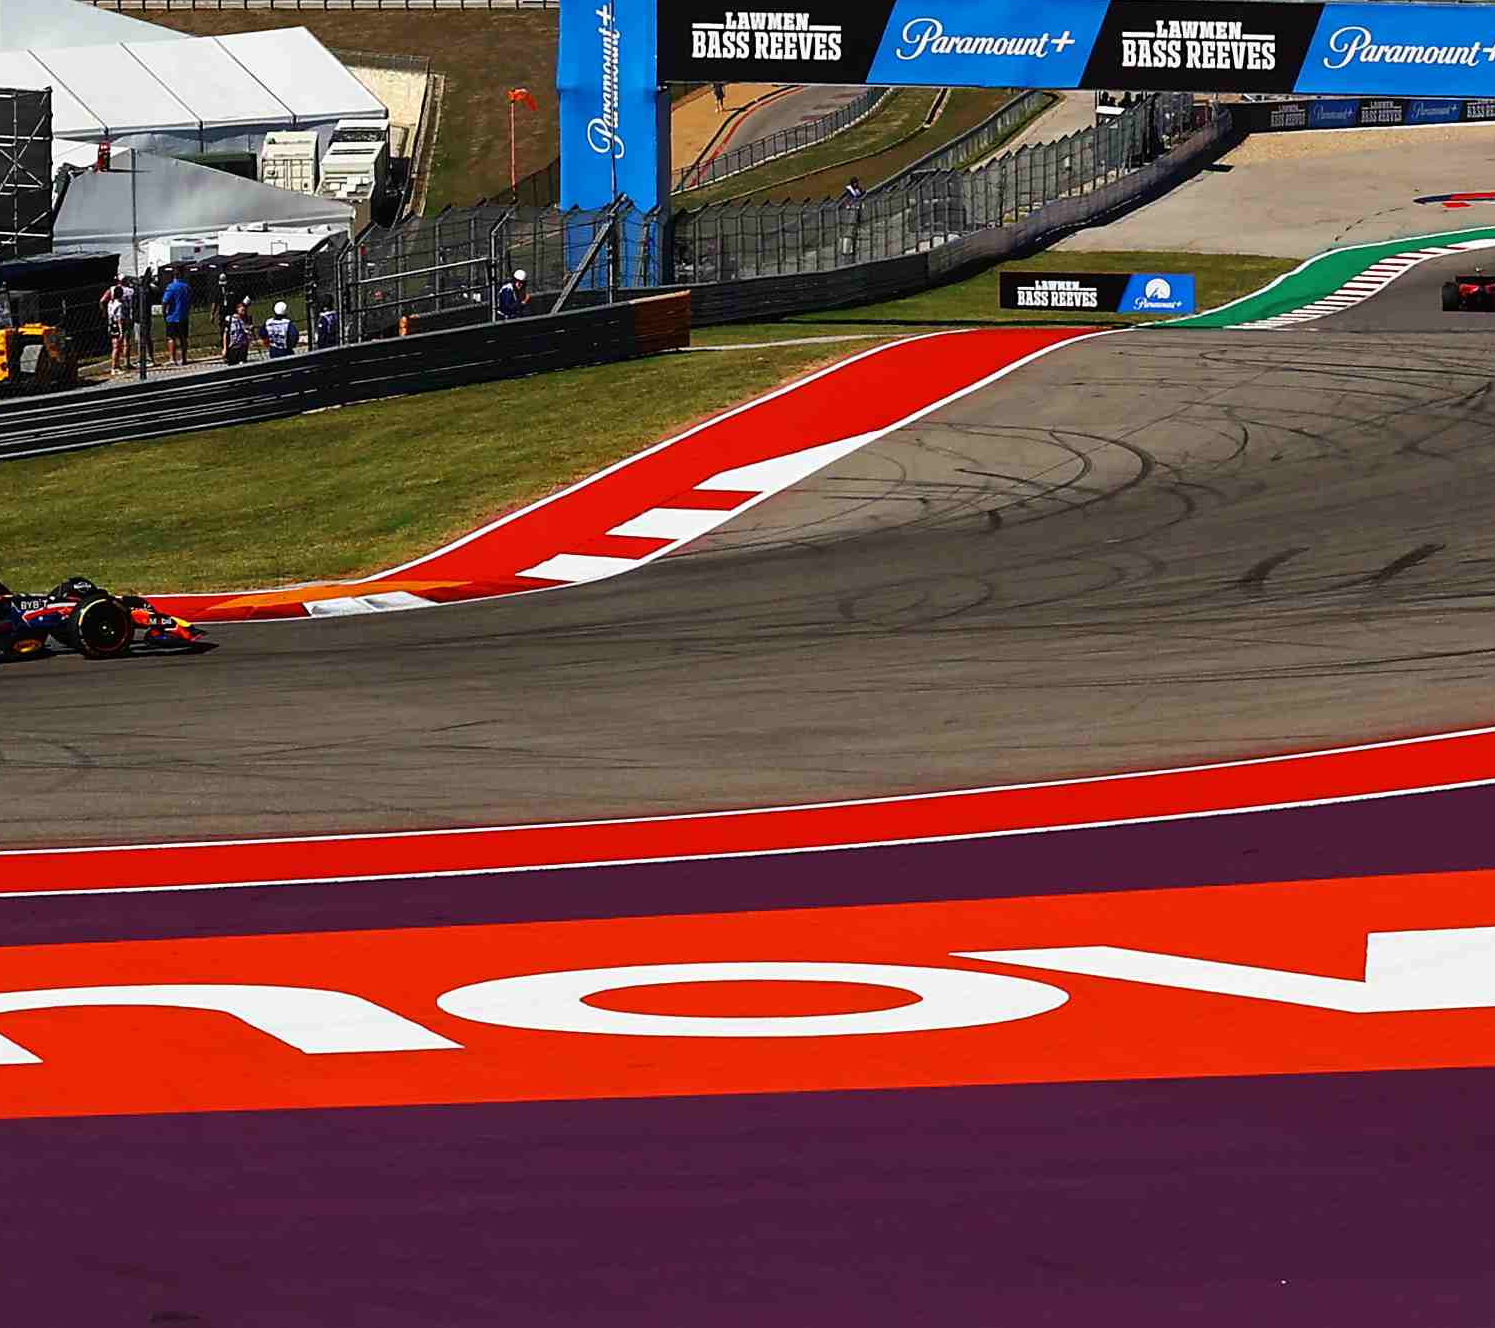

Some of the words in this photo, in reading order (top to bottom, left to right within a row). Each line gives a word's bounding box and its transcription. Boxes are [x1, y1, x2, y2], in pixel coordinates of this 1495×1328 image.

[725, 12, 809, 30] LAWMEN
[1155, 21, 1242, 39] LAWMEN
[692, 31, 749, 59] BASS
[755, 31, 841, 61] REEVES
[897, 18, 1074, 59] Paramount+
[1122, 40, 1181, 68] BASS
[1187, 41, 1275, 69] REEVES
[587, 5, 624, 158] Paramount+
[1035, 281, 1080, 290] LAWMEN
[1018, 291, 1048, 307] BASS
[1051, 292, 1097, 307] REEVES
